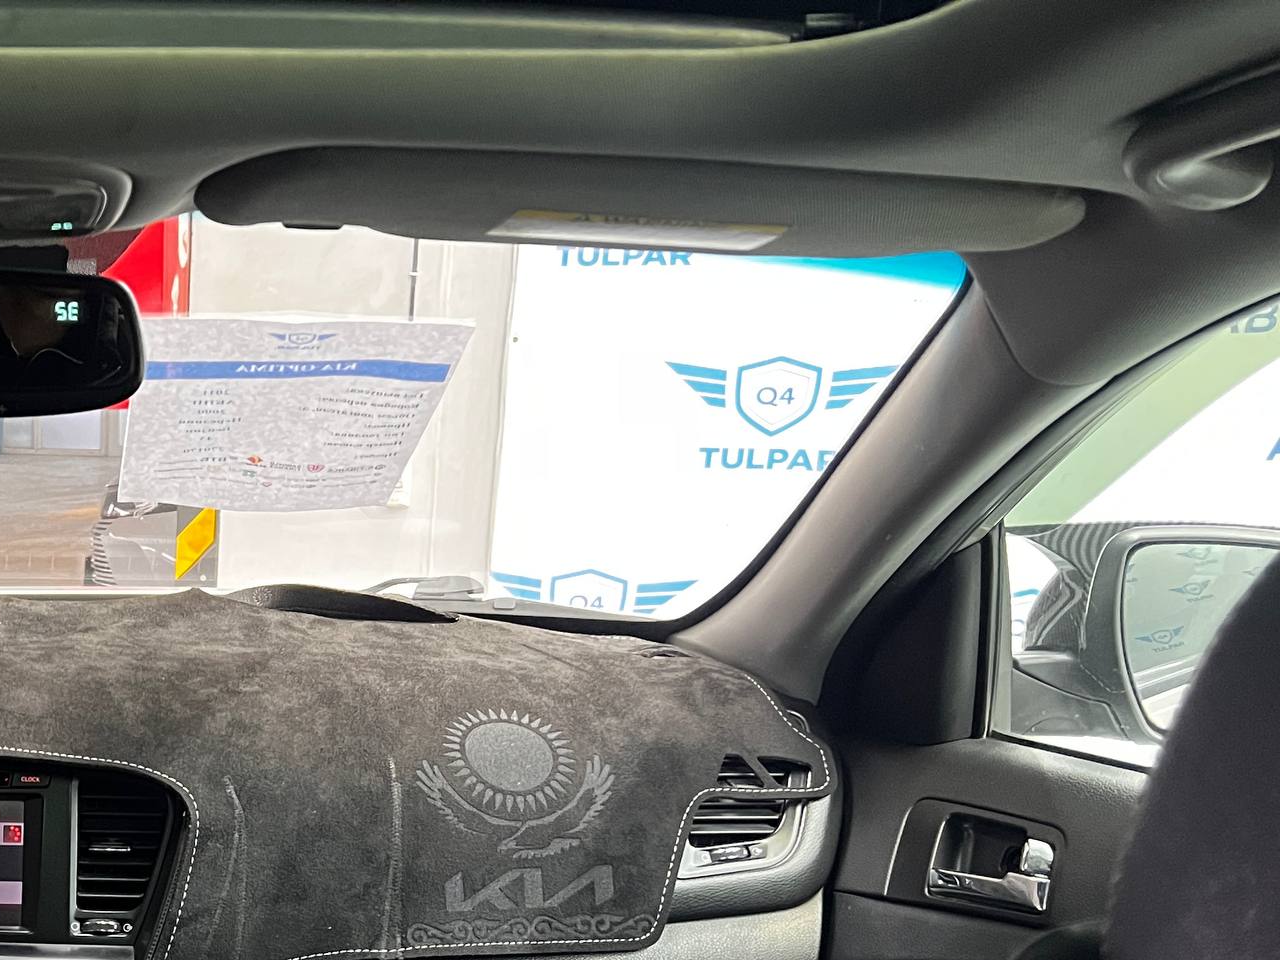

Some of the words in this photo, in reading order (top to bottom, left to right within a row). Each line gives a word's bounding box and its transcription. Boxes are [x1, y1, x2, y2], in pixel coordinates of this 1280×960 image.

[557, 245, 694, 267] TULPAR
[54, 301, 79, 322] SE
[756, 386, 795, 407] Q4
[20, 775, 41, 783] CLOCK
[444, 864, 615, 912] KIA
